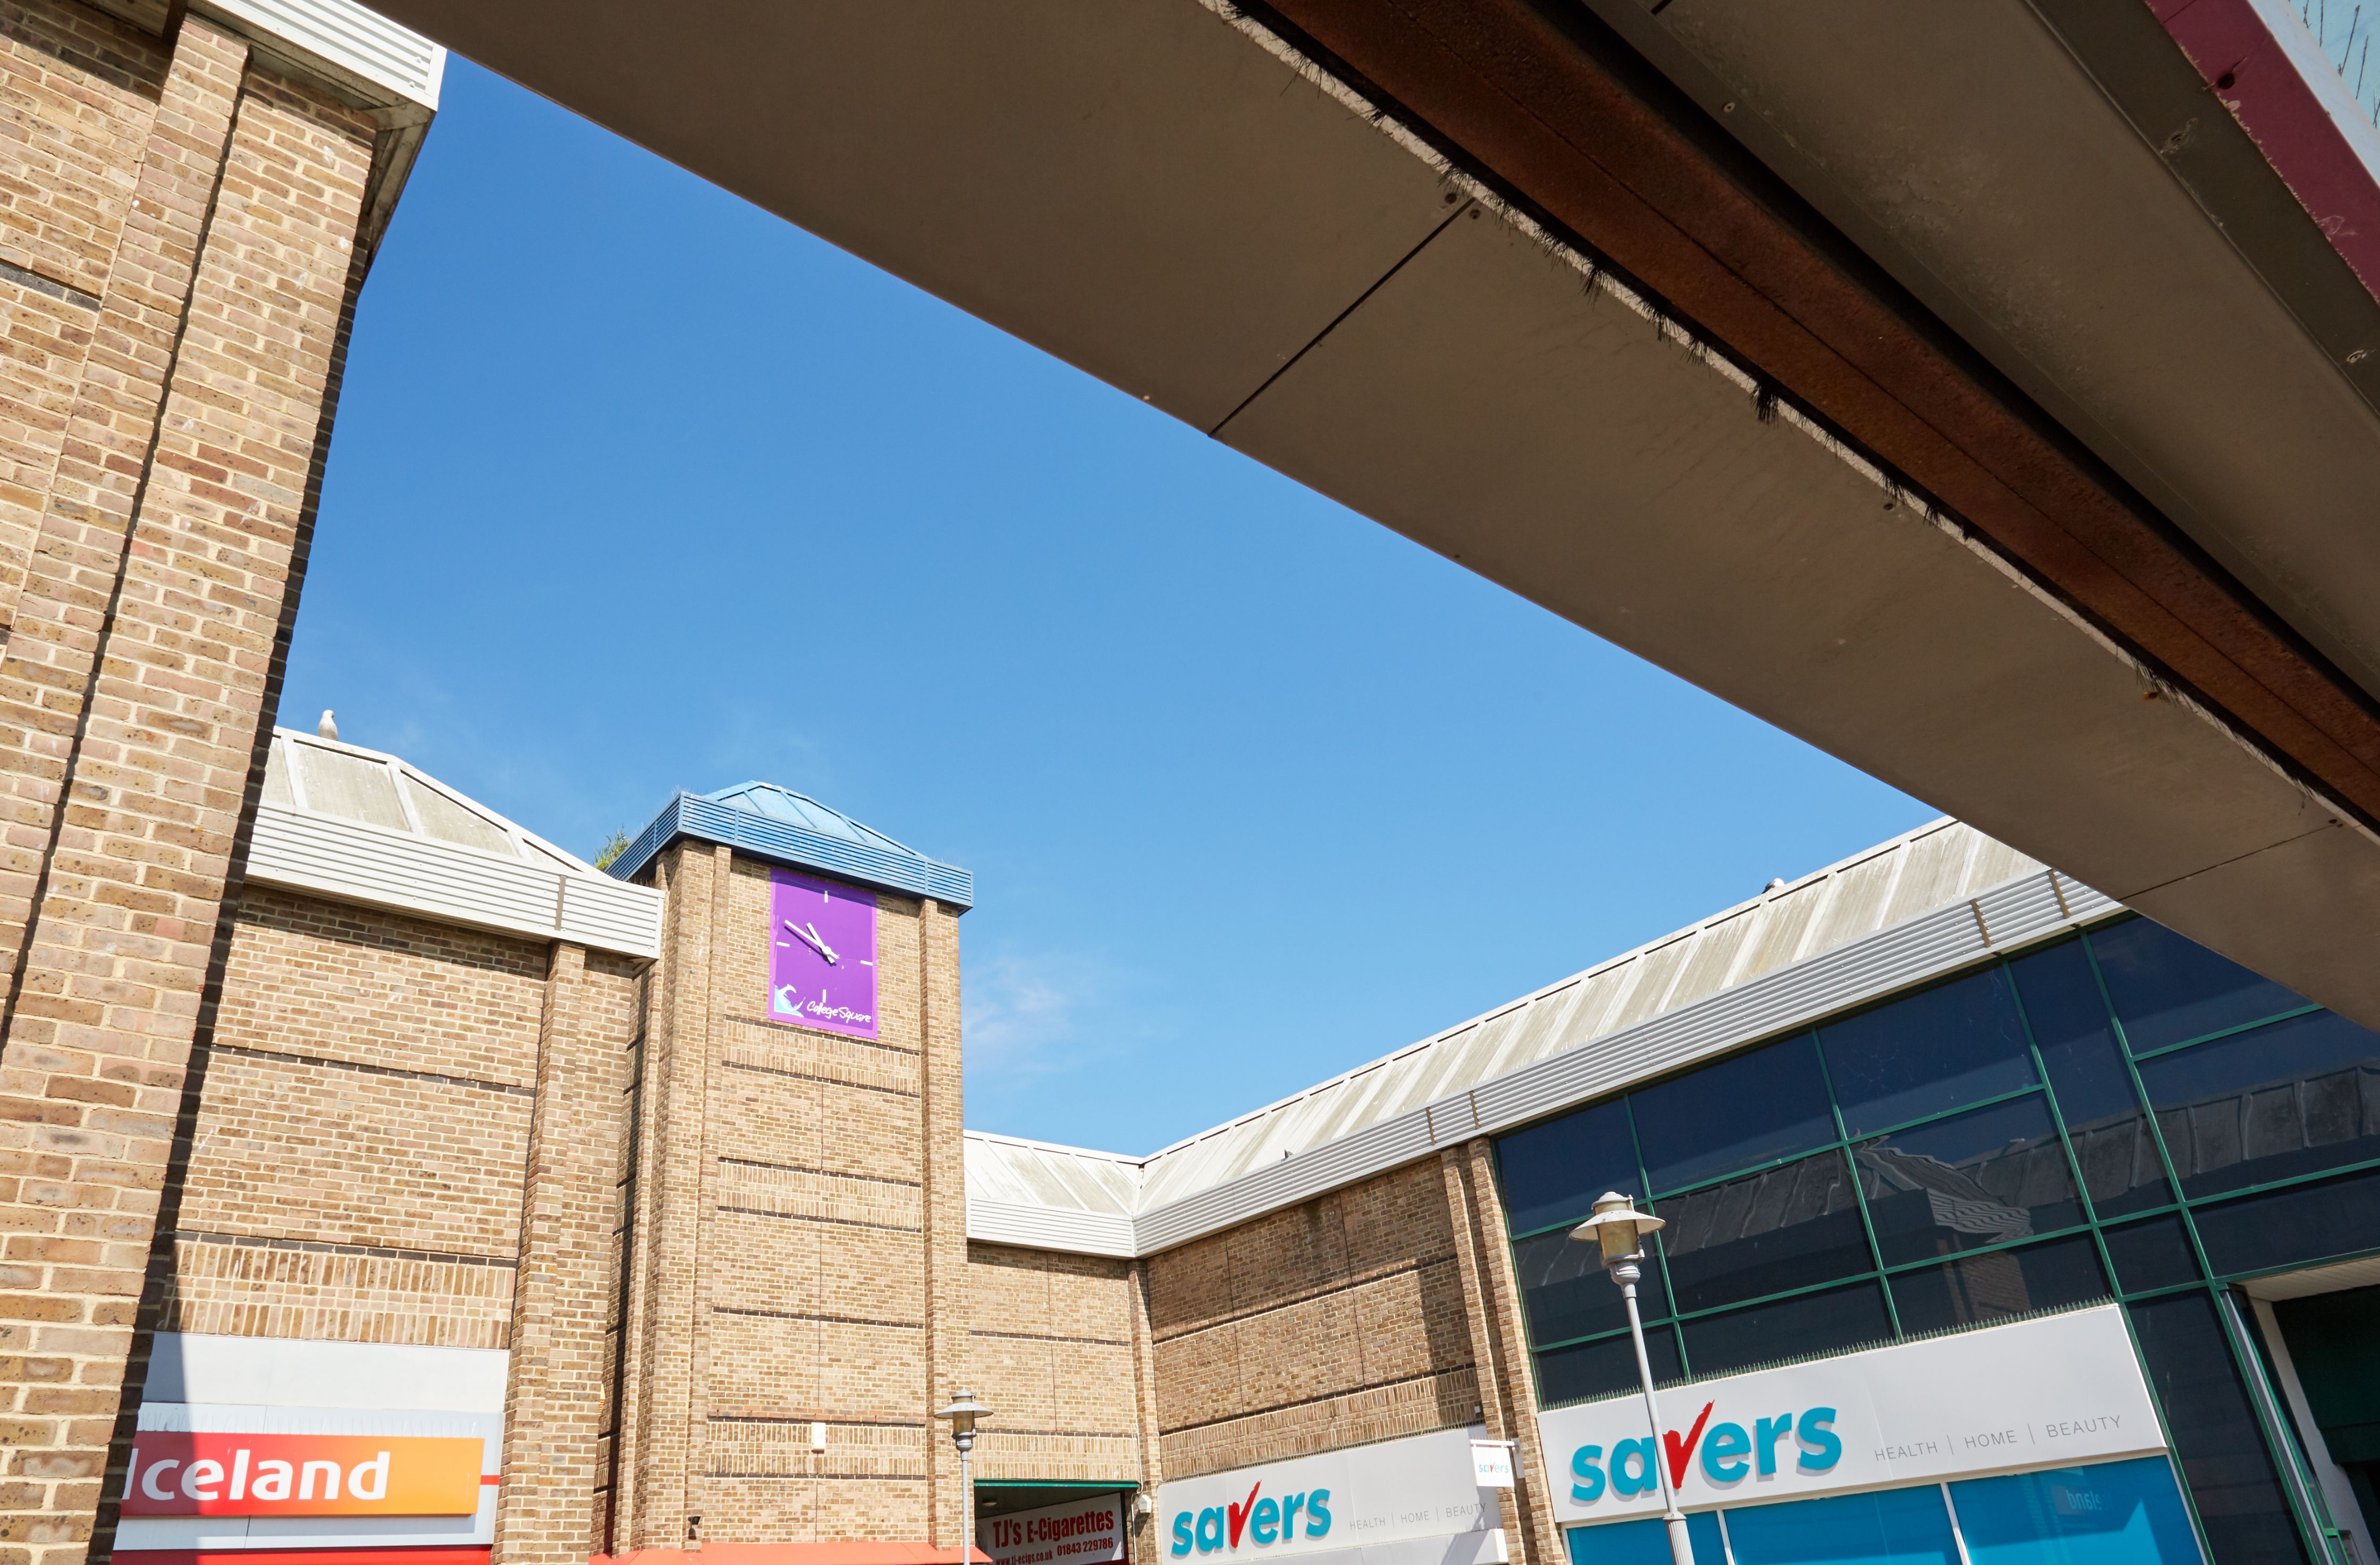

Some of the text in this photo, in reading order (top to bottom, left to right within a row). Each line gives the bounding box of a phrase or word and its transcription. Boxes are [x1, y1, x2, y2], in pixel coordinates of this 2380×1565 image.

[807, 1000, 871, 1024] College Square
[1572, 1400, 1842, 1501] savers
[1875, 1415, 2121, 1461] HEALTH HOME BEAUTY
[1478, 1461, 1509, 1474] savers
[993, 1510, 1114, 1548] TJ's E-Cigarettes
[1171, 1479, 1332, 1555] savers
[1349, 1503, 1486, 1530] HEALTH HOME BEAUTY
[1057, 1542, 1082, 1556] 01843
[1083, 1537, 1113, 1552] 229786
